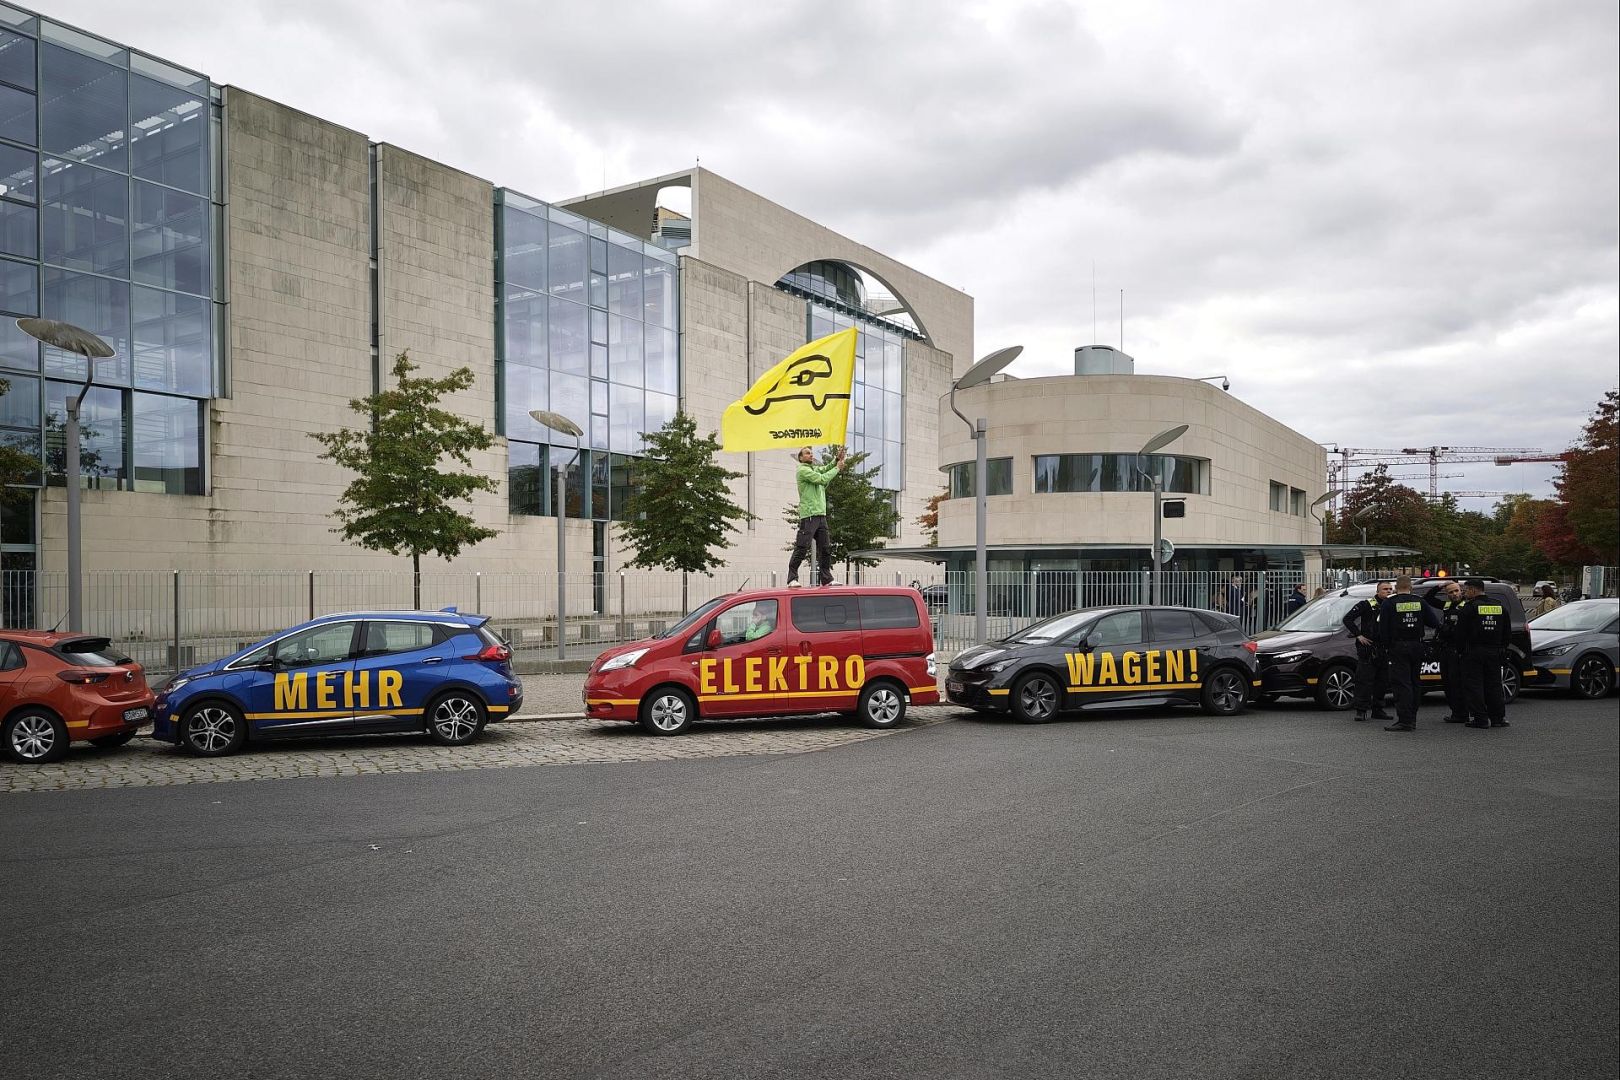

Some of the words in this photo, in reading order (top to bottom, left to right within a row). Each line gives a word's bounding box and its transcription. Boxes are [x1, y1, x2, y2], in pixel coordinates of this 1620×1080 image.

[1479, 606, 1501, 614] POLIZEI
[700, 655, 865, 694] ELEKTRO
[1065, 649, 1197, 685] WAGEN!
[274, 669, 403, 711] MEHR
